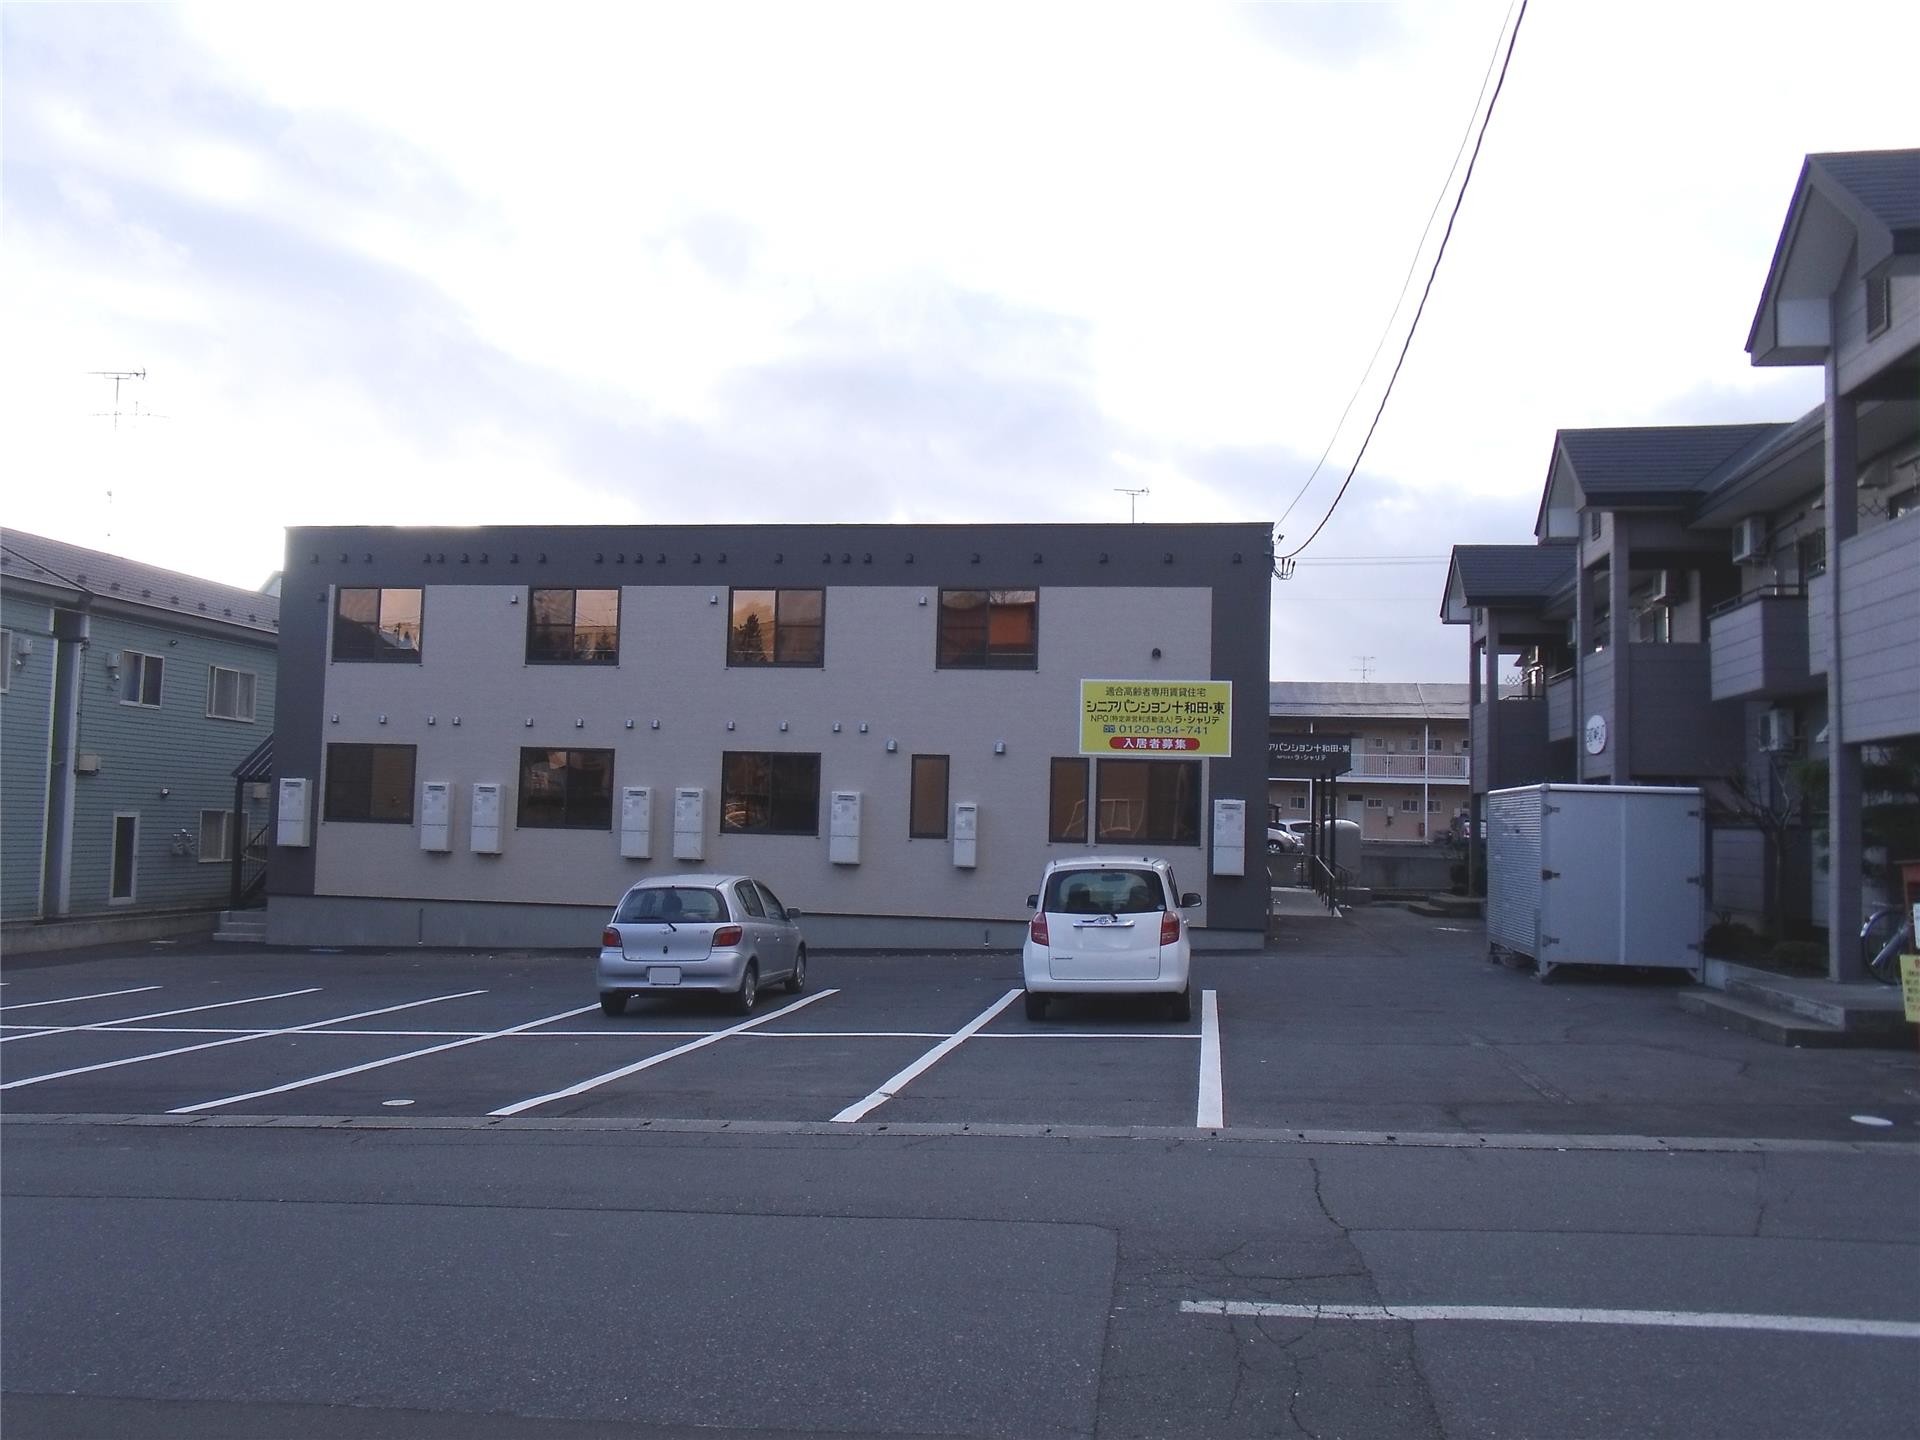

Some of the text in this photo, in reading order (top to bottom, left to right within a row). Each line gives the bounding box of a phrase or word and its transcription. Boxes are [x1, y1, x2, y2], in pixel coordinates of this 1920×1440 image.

[1105, 686, 1207, 697] 適合高齢者専用賃貸住宅
[1086, 699, 1225, 715] シニアパンション十和田・東
[1119, 725, 1209, 735] 0120-934-741
[1123, 737, 1188, 750] 入居者募集
